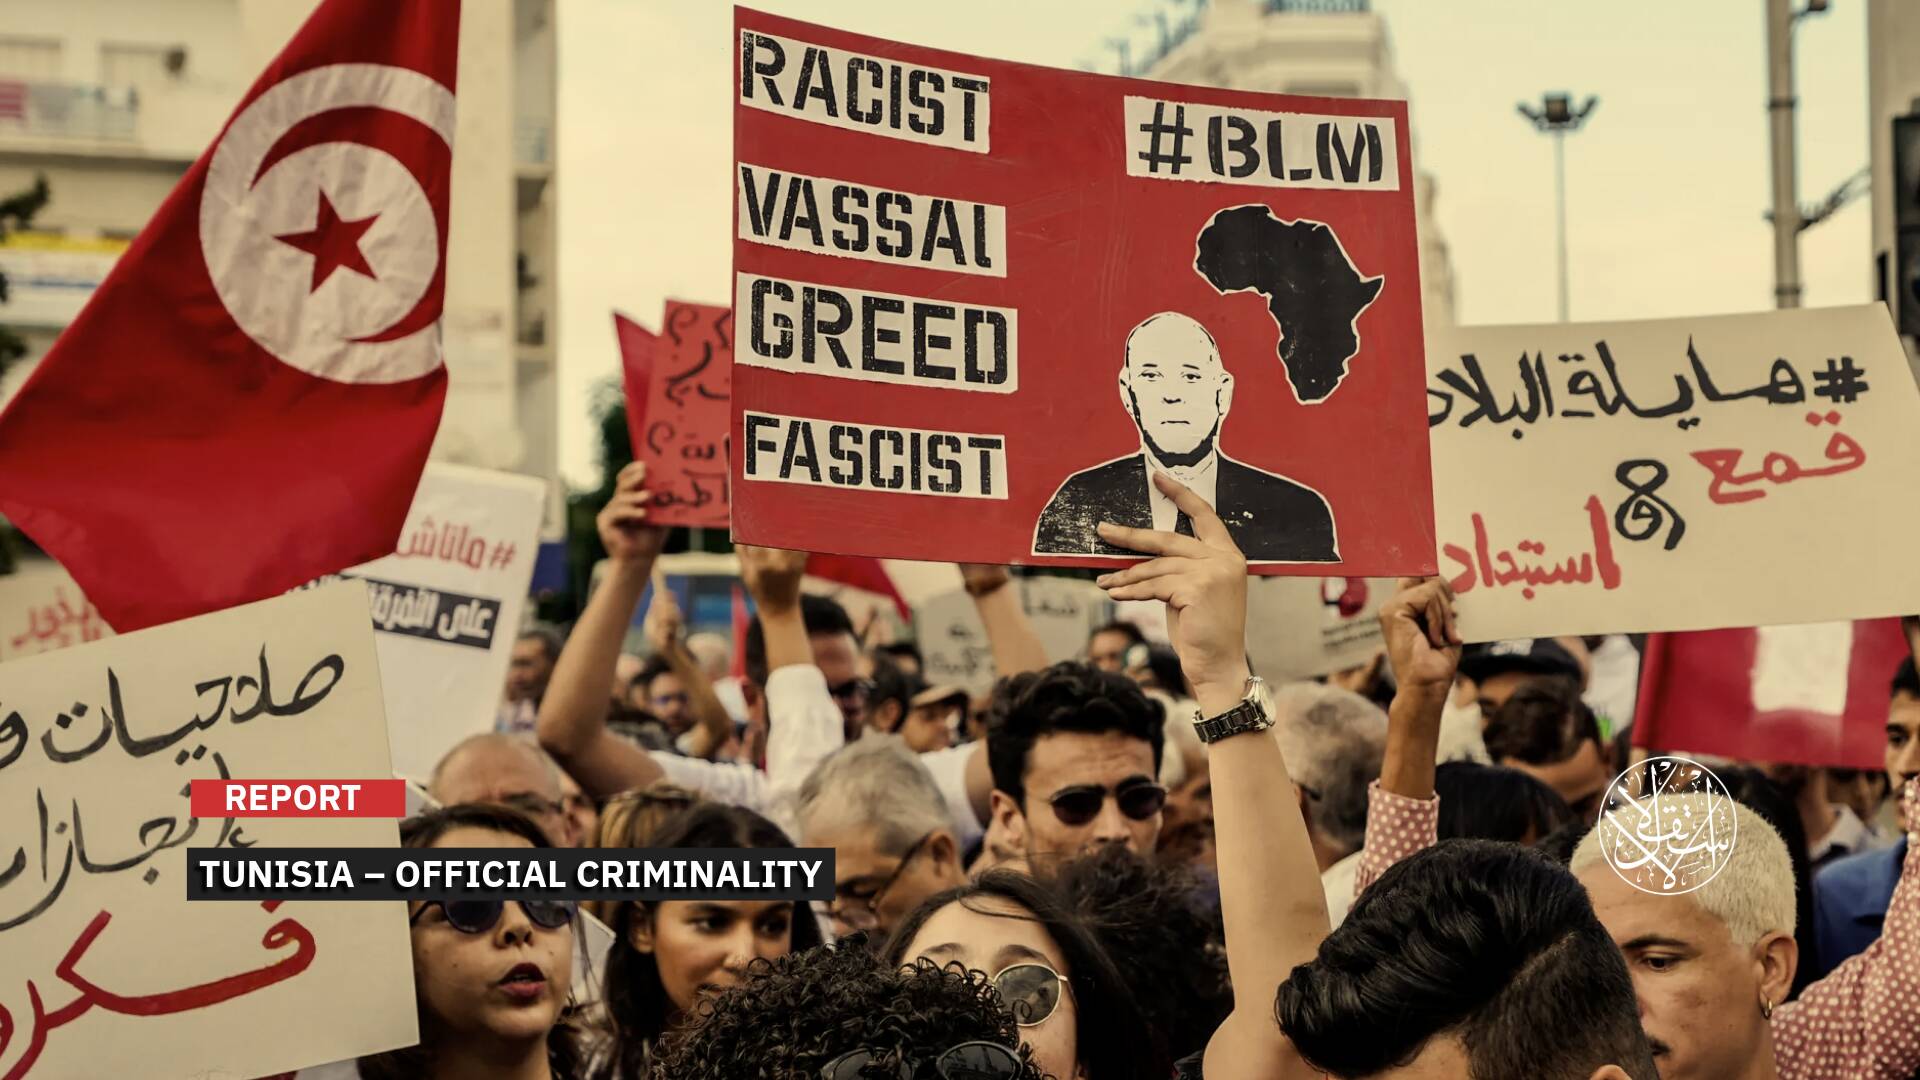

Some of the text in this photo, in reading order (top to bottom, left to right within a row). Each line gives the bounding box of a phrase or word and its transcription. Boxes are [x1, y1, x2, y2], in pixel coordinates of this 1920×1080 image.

[742, 31, 989, 142] RACIST
[1138, 101, 1384, 184] #BLM
[750, 278, 1008, 385] GREED
[1427, 351, 1554, 440] البلاد
[745, 414, 1003, 496] FASCIST
[1690, 410, 1867, 505] قمع
[1443, 494, 1622, 600] استبداد
[40, 640, 345, 766] صلاحيات
